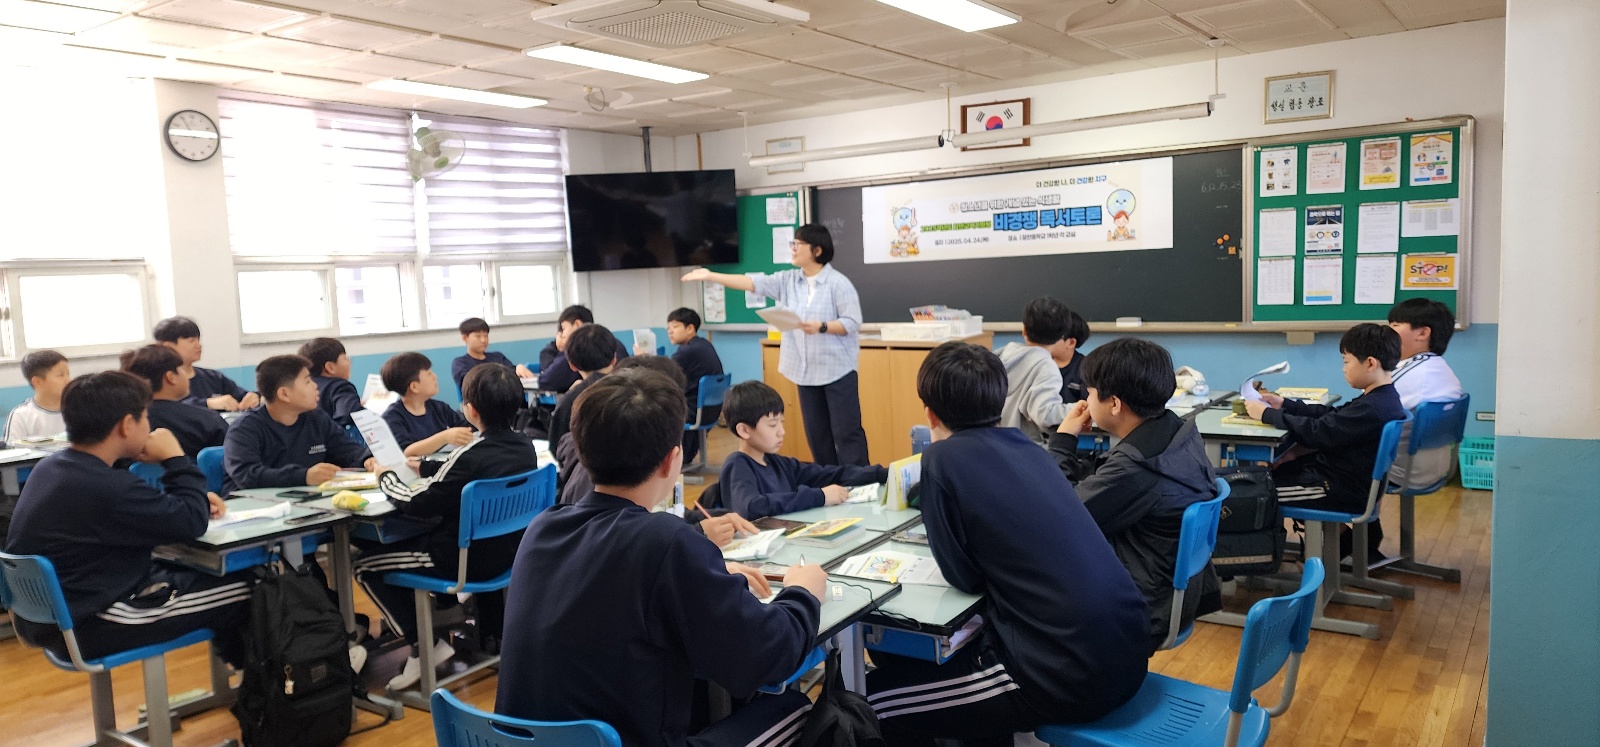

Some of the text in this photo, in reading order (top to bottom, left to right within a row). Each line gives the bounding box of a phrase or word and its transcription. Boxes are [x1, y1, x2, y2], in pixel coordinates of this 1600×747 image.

[1043, 179, 1060, 188] 건강한
[1076, 176, 1094, 185] 건강한
[1095, 175, 1107, 183] 지구
[993, 210, 1039, 232] 비경쟁
[1040, 205, 1102, 229] 독서토론
